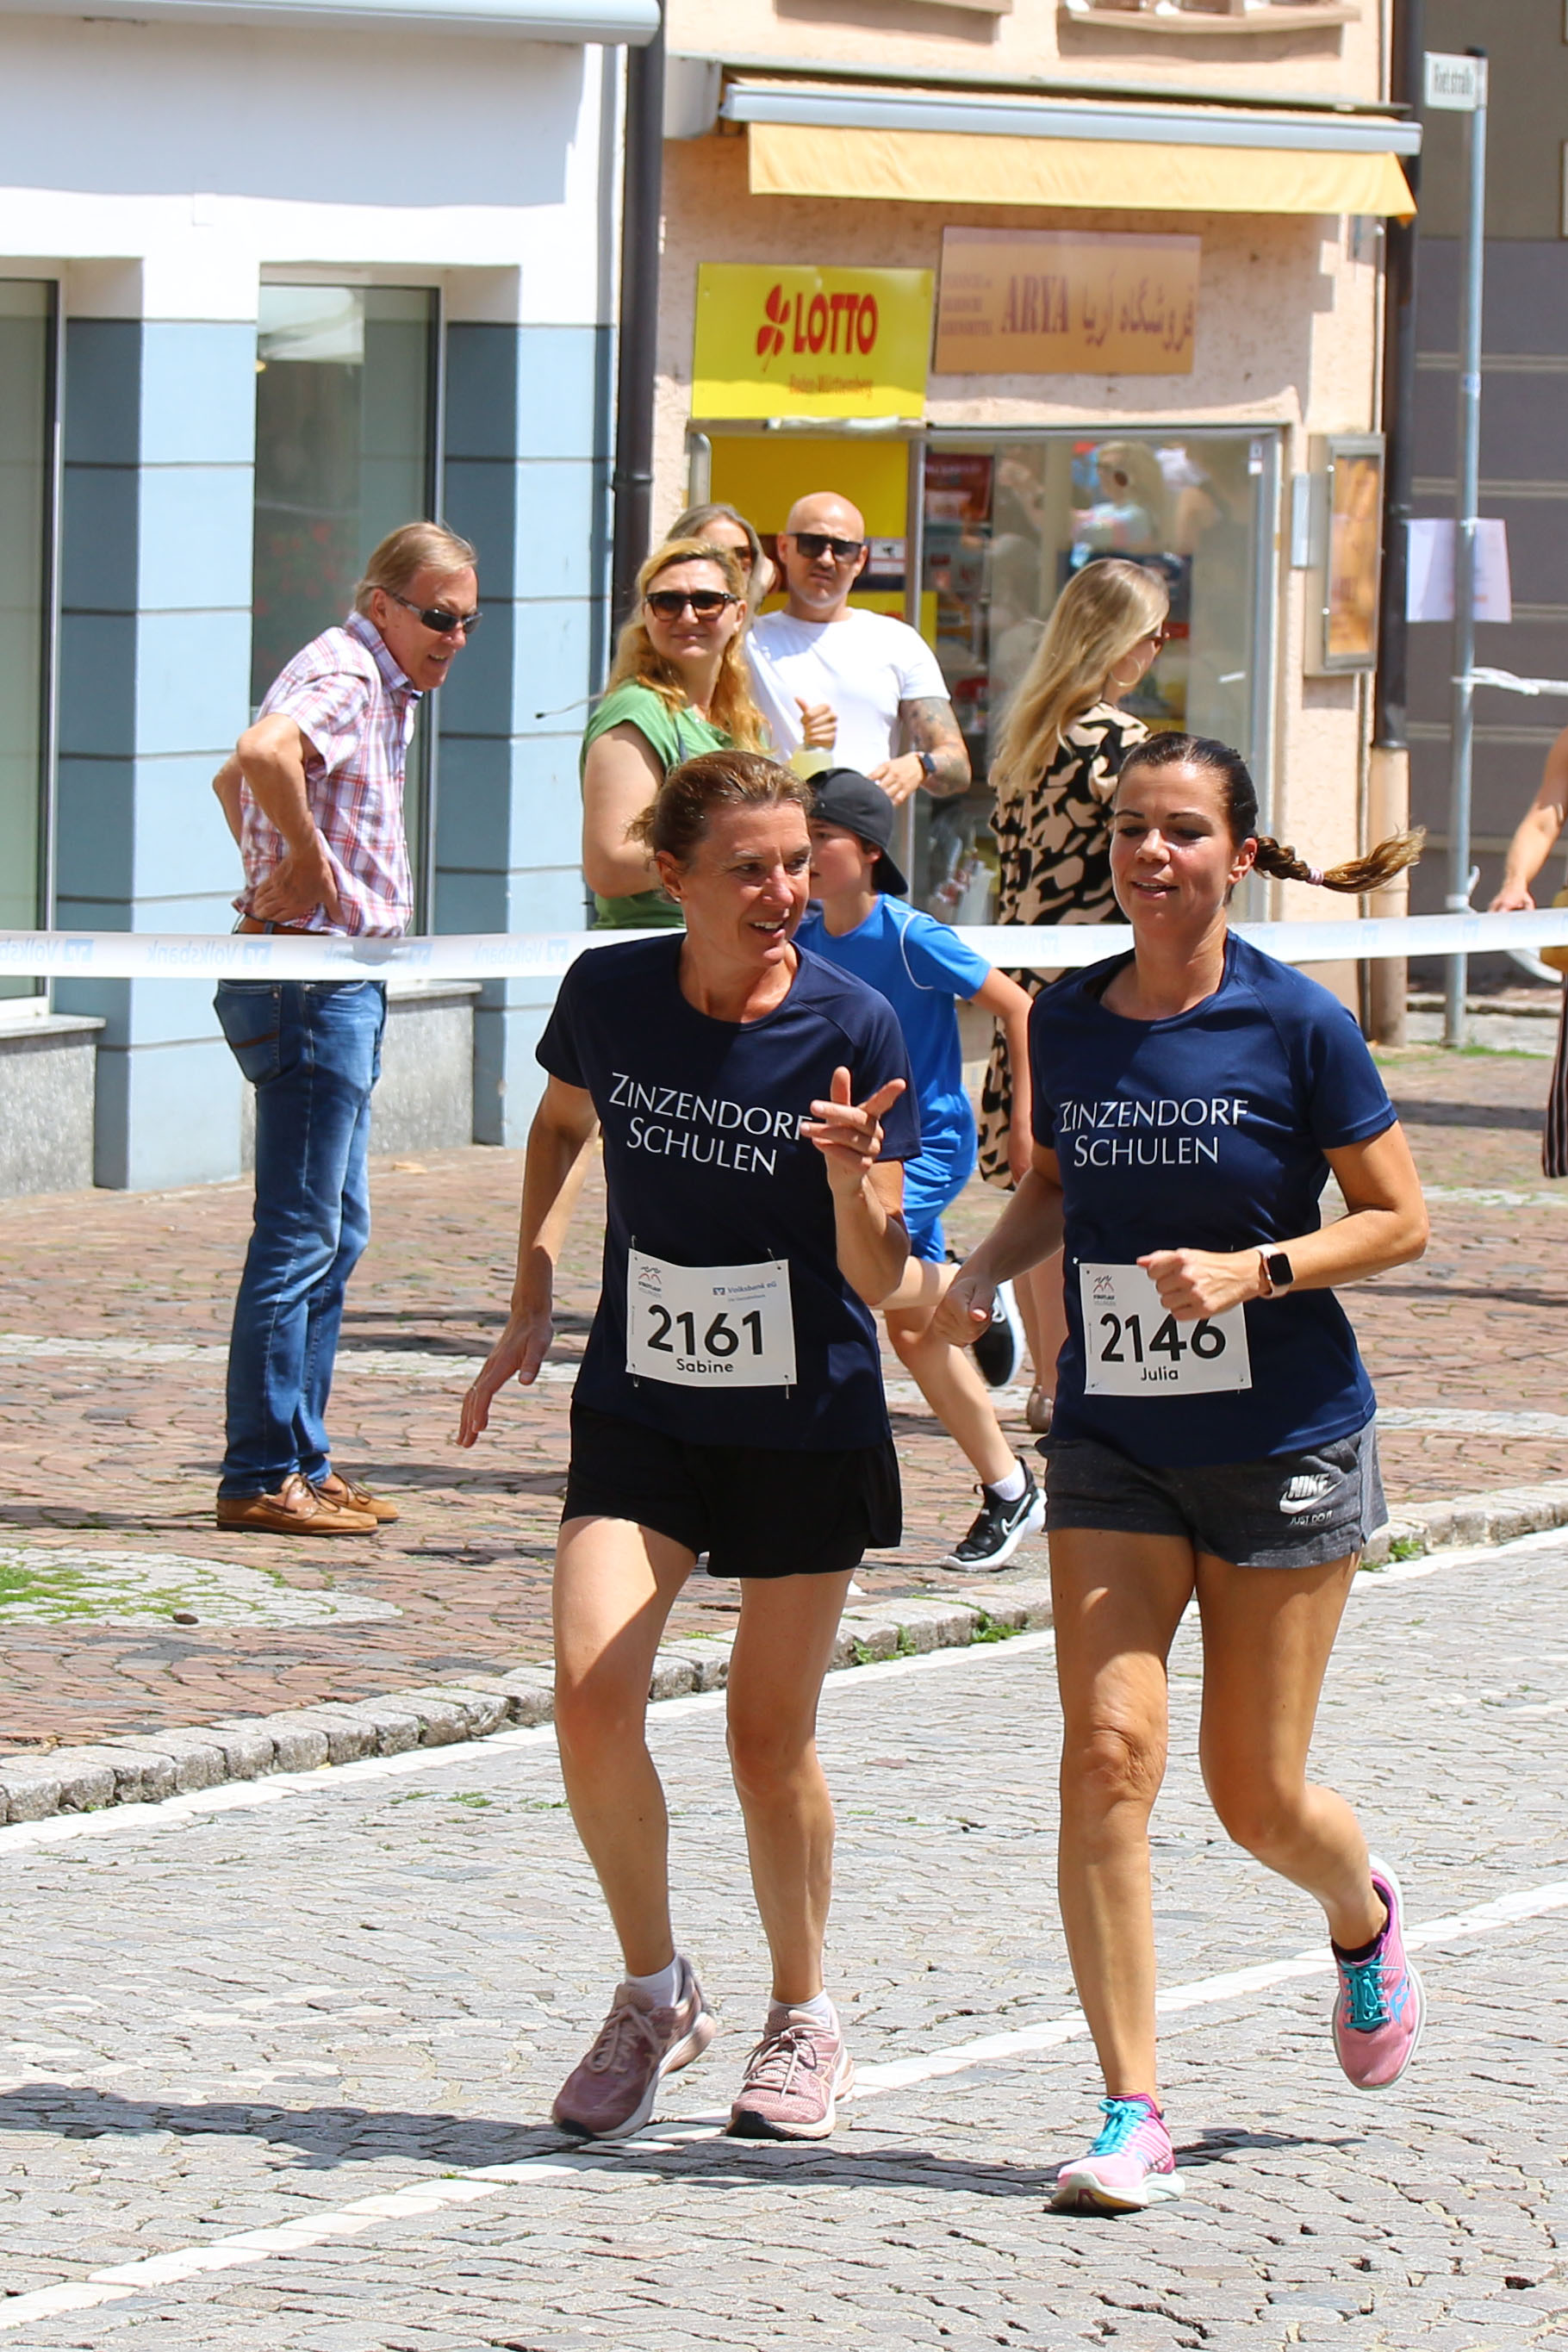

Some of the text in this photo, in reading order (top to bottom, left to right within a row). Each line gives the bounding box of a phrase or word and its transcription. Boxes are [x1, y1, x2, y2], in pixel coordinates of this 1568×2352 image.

[1000, 275, 1069, 334] ARYA
[792, 293, 879, 355] LOTTO
[1059, 1097, 1249, 1134] ZINZENDORF
[625, 1117, 778, 1177] SCHULEN
[1073, 1134, 1219, 1167] SCHULEN
[647, 1304, 764, 1358] 2161
[1099, 1312, 1227, 1364] 2146
[675, 1358, 734, 1374] Sabine
[1139, 1366, 1179, 1381] Julia
[1287, 1472, 1331, 1500] NIKE
[1311, 1512, 1326, 1523] DO
